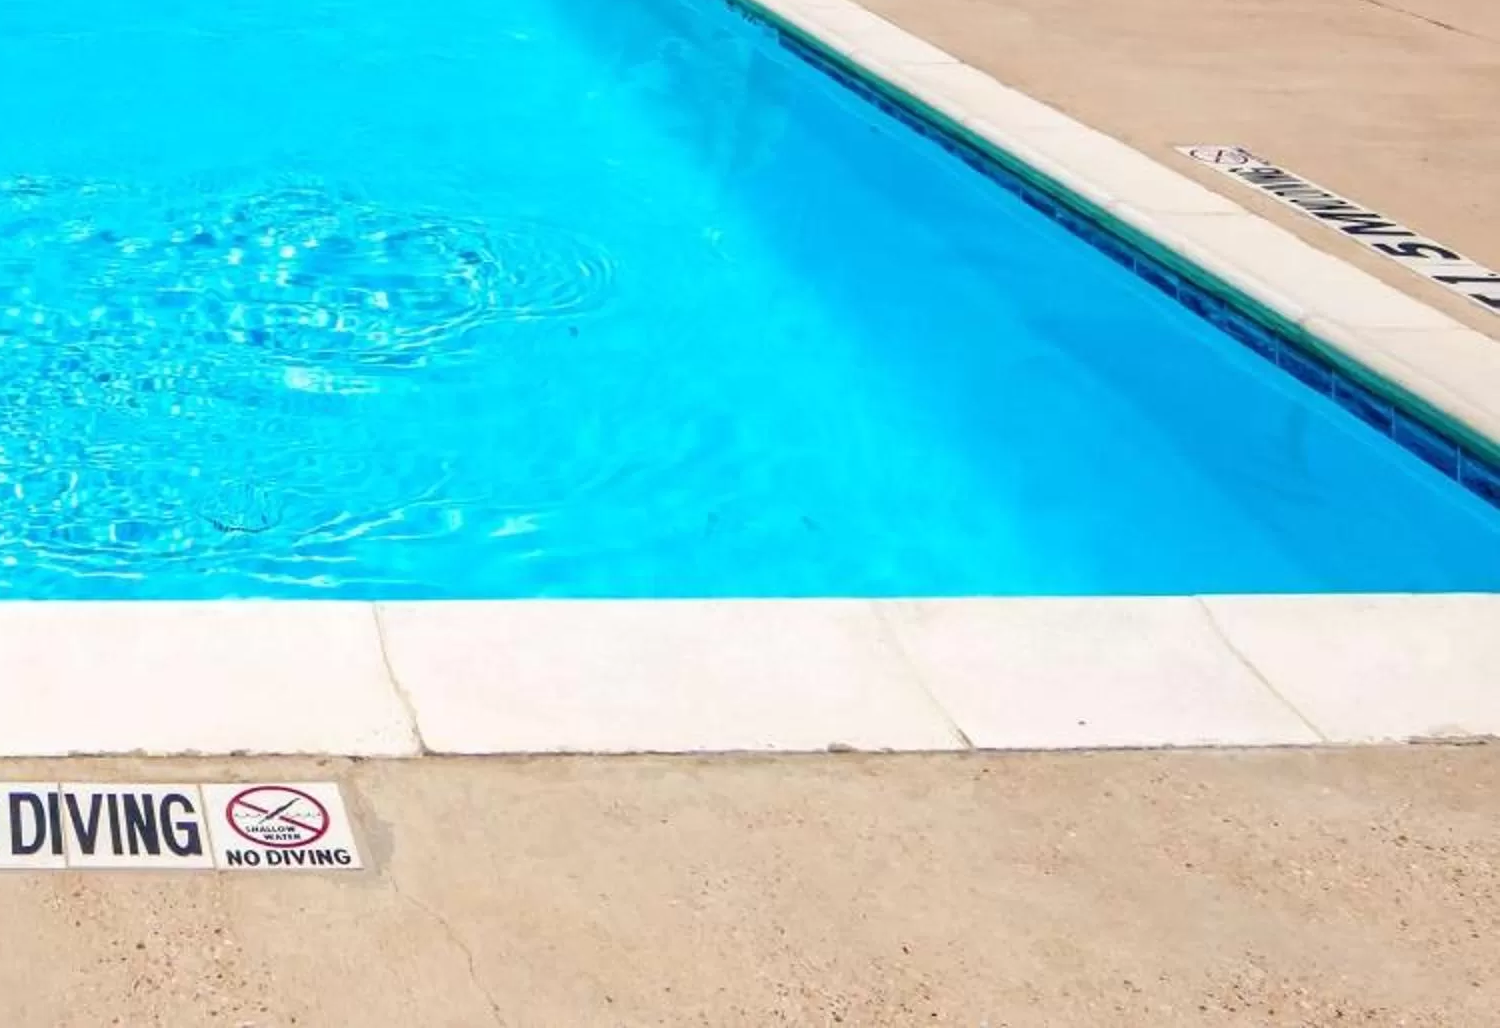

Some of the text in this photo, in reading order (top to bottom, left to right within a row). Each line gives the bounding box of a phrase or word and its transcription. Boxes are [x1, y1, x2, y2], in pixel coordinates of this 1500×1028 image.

[8, 791, 203, 857] DIVING
[245, 825, 297, 833] SHALLOW
[263, 833, 302, 841] WATER
[226, 849, 351, 865] NO DIVING
